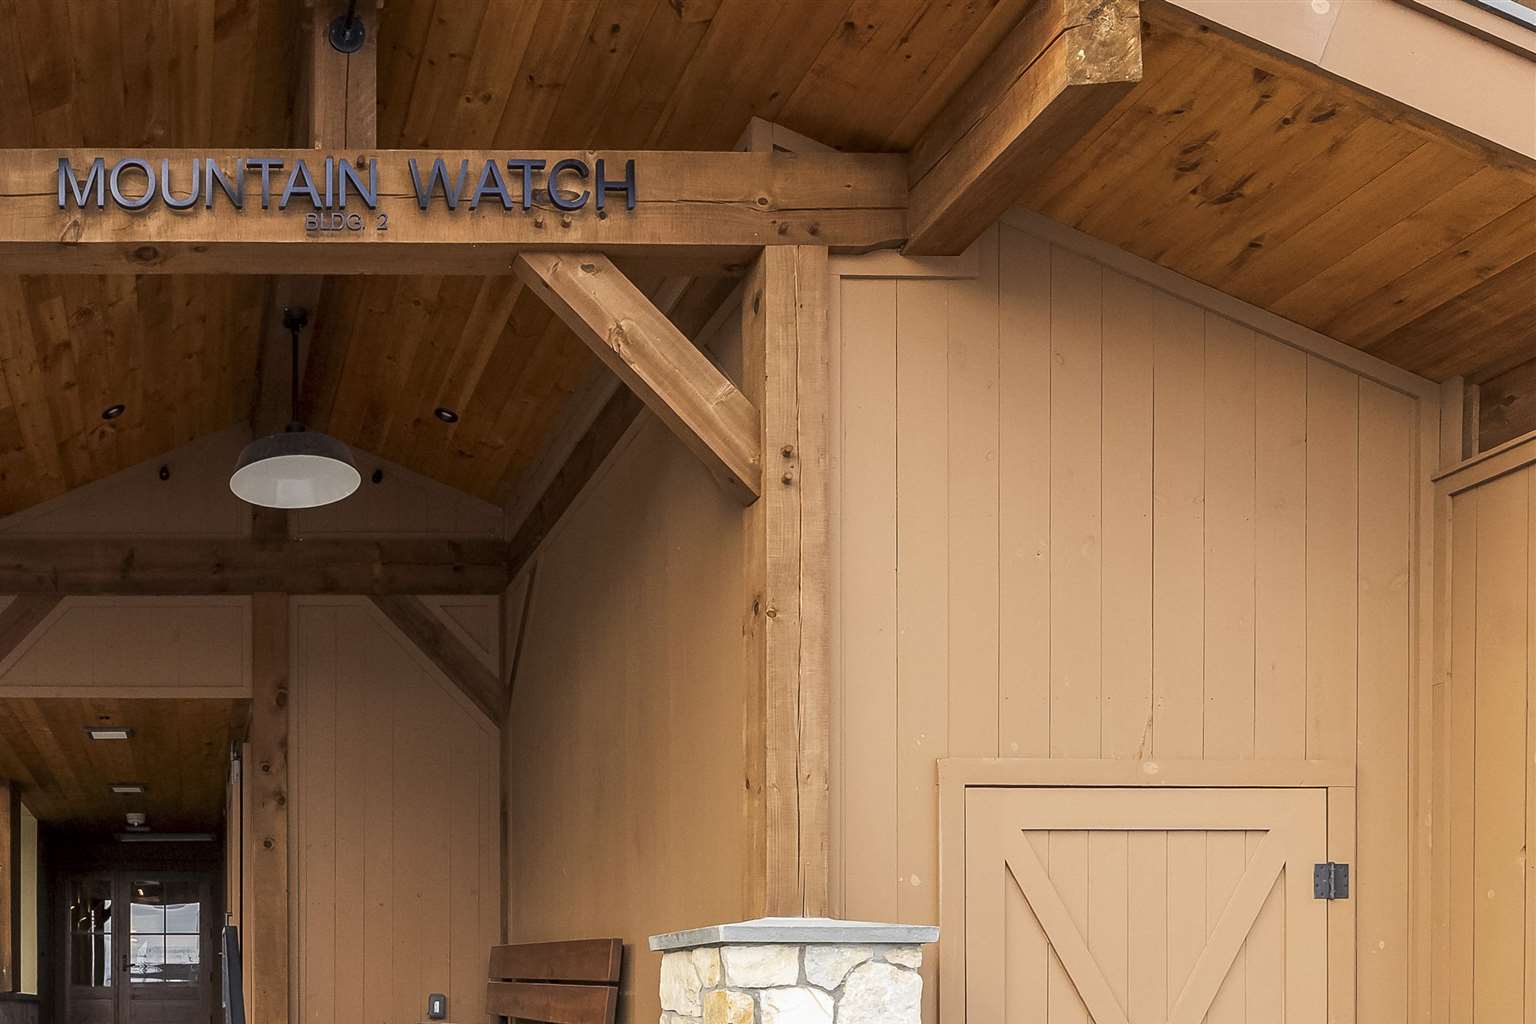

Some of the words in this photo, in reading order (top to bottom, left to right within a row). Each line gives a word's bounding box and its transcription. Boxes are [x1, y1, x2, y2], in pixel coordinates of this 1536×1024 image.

[57, 156, 377, 210] MOUNTAIN
[408, 158, 636, 212] WATCH
[306, 212, 367, 231] BLDG.
[376, 213, 389, 231] 2
